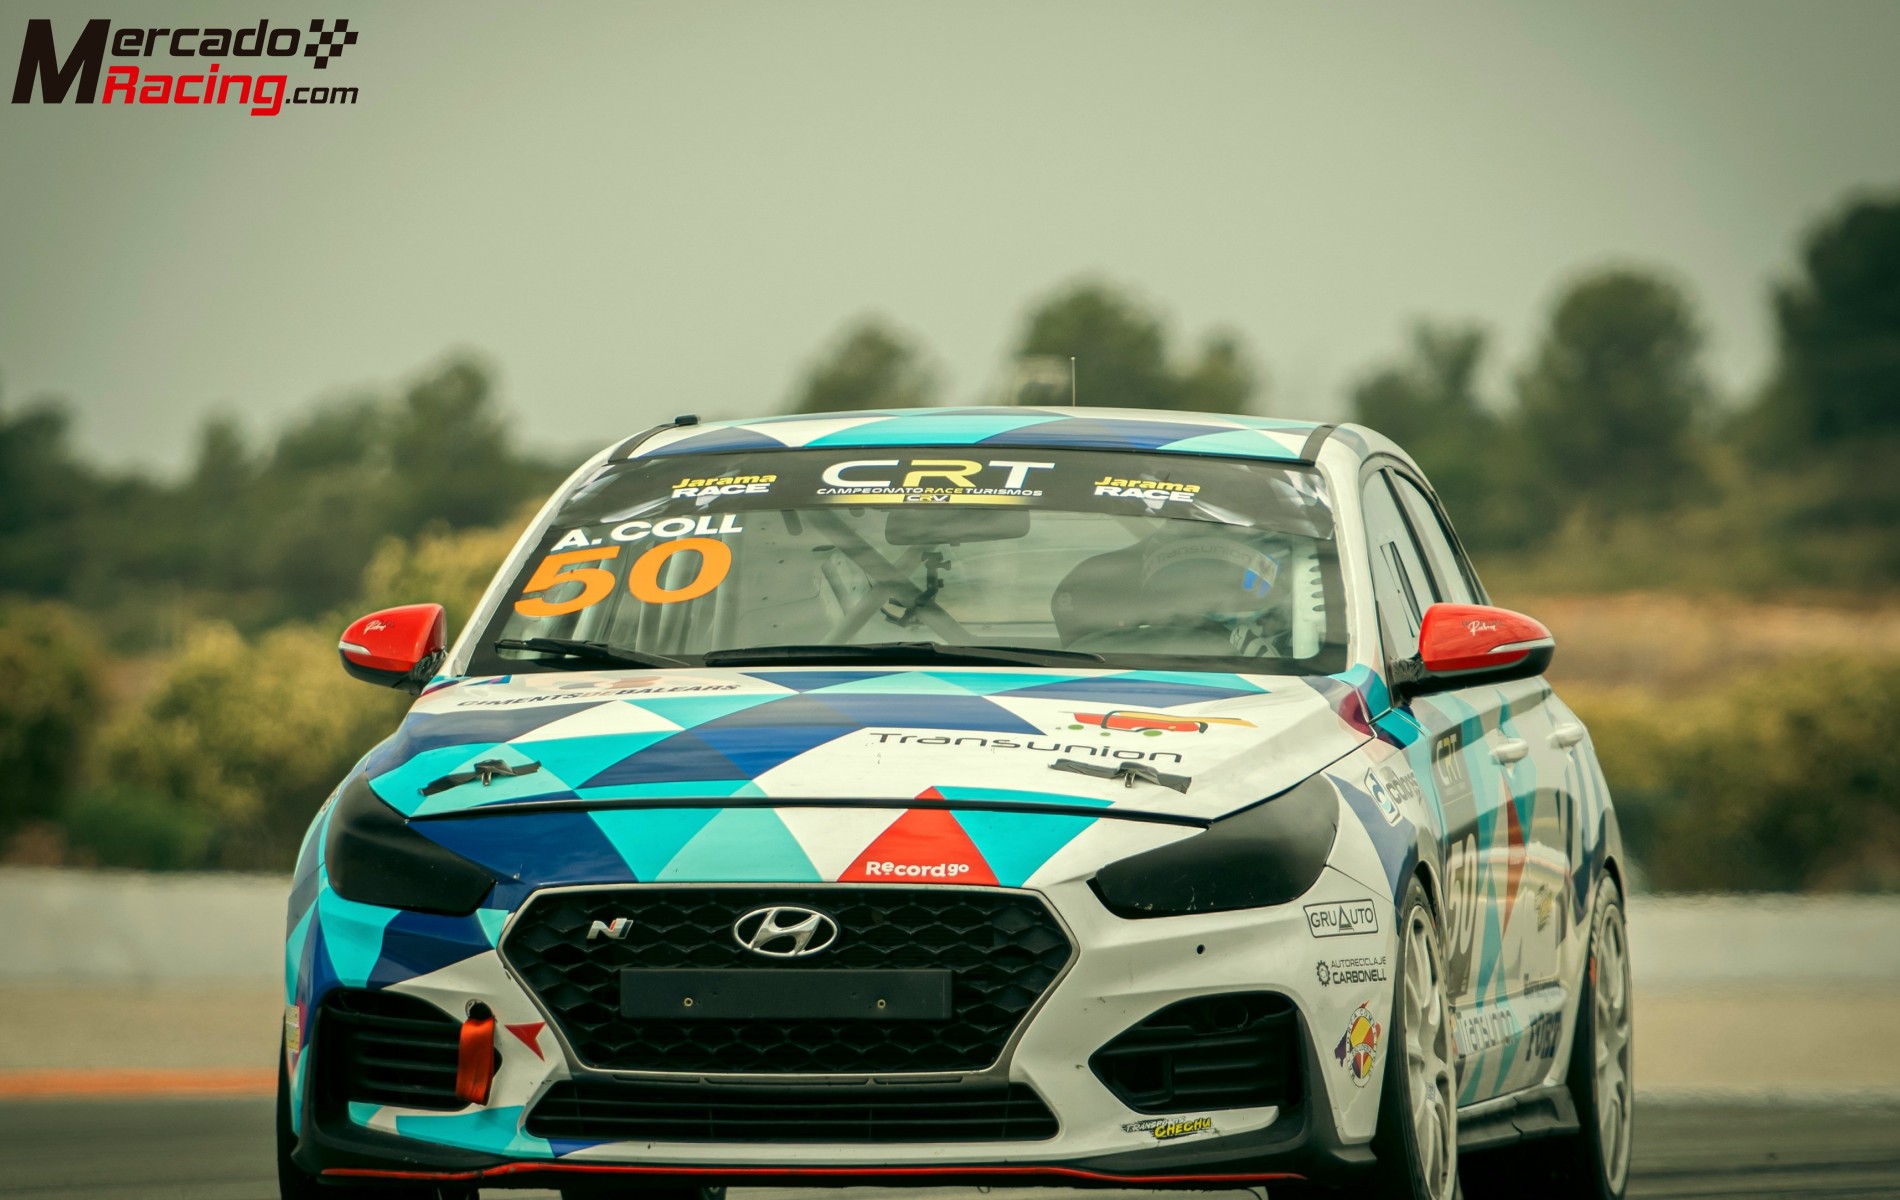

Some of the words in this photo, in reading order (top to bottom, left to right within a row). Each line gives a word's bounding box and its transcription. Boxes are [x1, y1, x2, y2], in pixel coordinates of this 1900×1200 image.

[672, 474, 777, 489] Jarama
[820, 458, 1056, 489] CRT
[671, 483, 771, 499] RACE
[1094, 476, 1201, 494] Jarama
[1094, 485, 1195, 503] RACE
[906, 495, 949, 503] CRV
[551, 528, 603, 551] A.
[610, 513, 743, 542] COLL
[514, 537, 733, 617] 50
[870, 732, 1183, 763] Transunion
[1331, 956, 1387, 969] AUTORECICLAJE
[1332, 968, 1387, 985] CARBONELL
[1154, 1116, 1212, 1139] CHECHU
